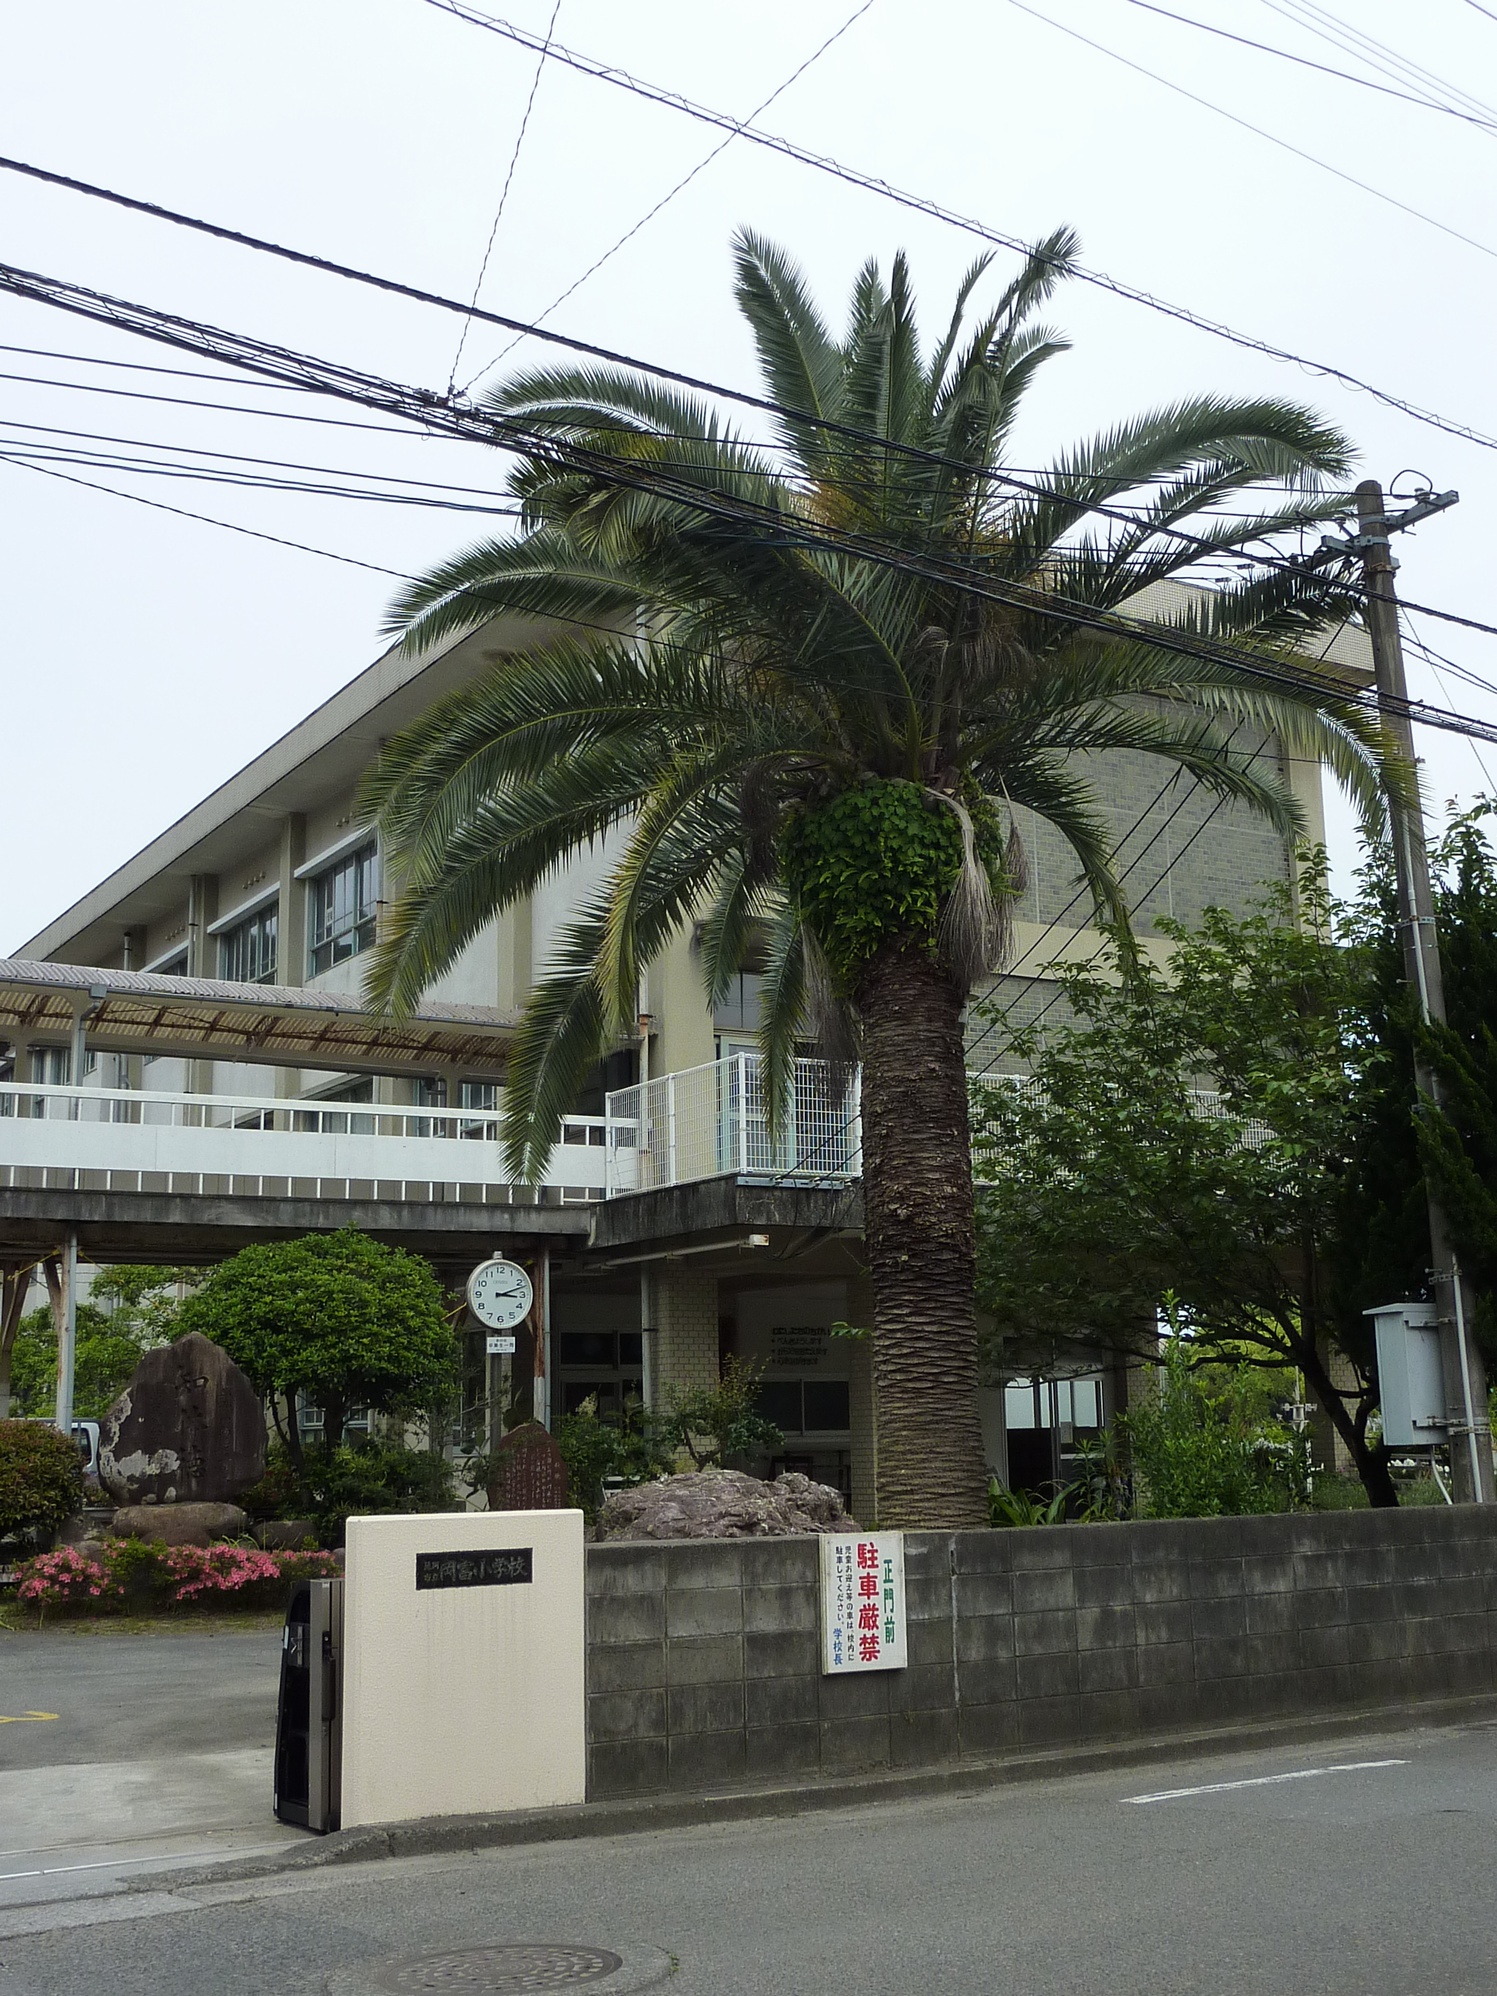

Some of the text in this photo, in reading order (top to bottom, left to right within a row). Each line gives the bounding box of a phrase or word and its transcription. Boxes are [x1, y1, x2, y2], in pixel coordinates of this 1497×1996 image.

[496, 1266, 505, 1274] 12
[519, 1291, 526, 1299] 3
[857, 1542, 881, 1663] 駐車厳禁
[883, 1559, 895, 1644] 正門前
[832, 1628, 843, 1666] 学校長
